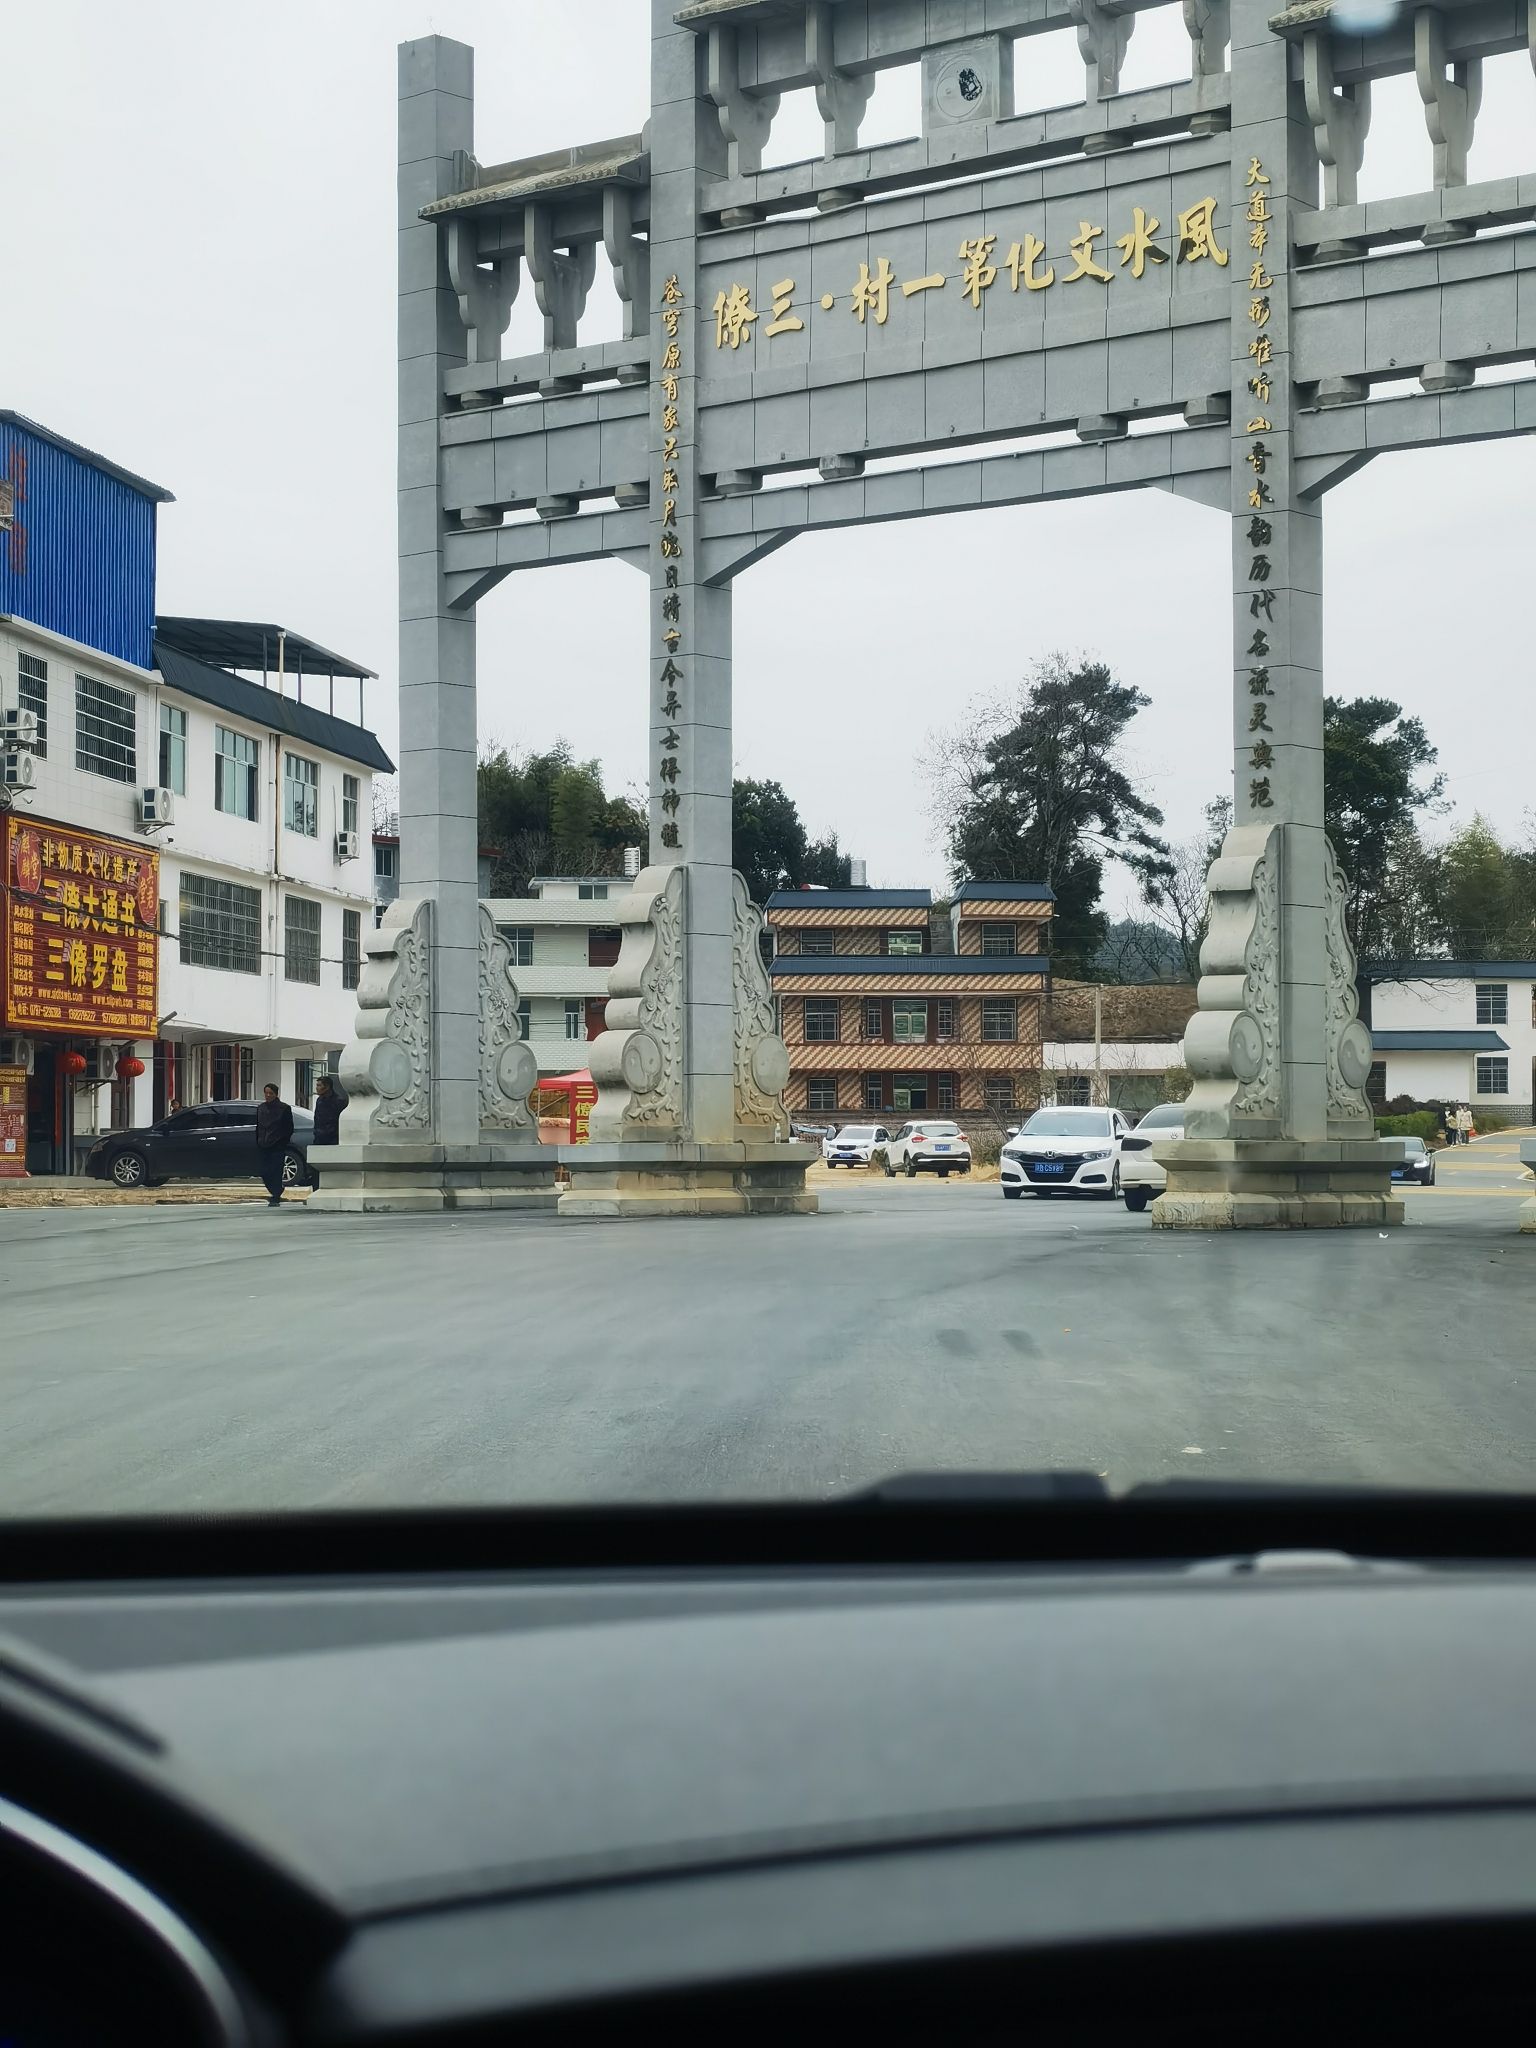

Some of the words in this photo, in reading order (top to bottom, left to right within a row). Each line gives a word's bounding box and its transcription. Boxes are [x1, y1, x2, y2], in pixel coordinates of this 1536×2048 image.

[42, 838, 138, 884] 非物质文化遗产
[42, 878, 136, 937] 三僚大通书
[46, 938, 128, 991] 三僚罗盘
